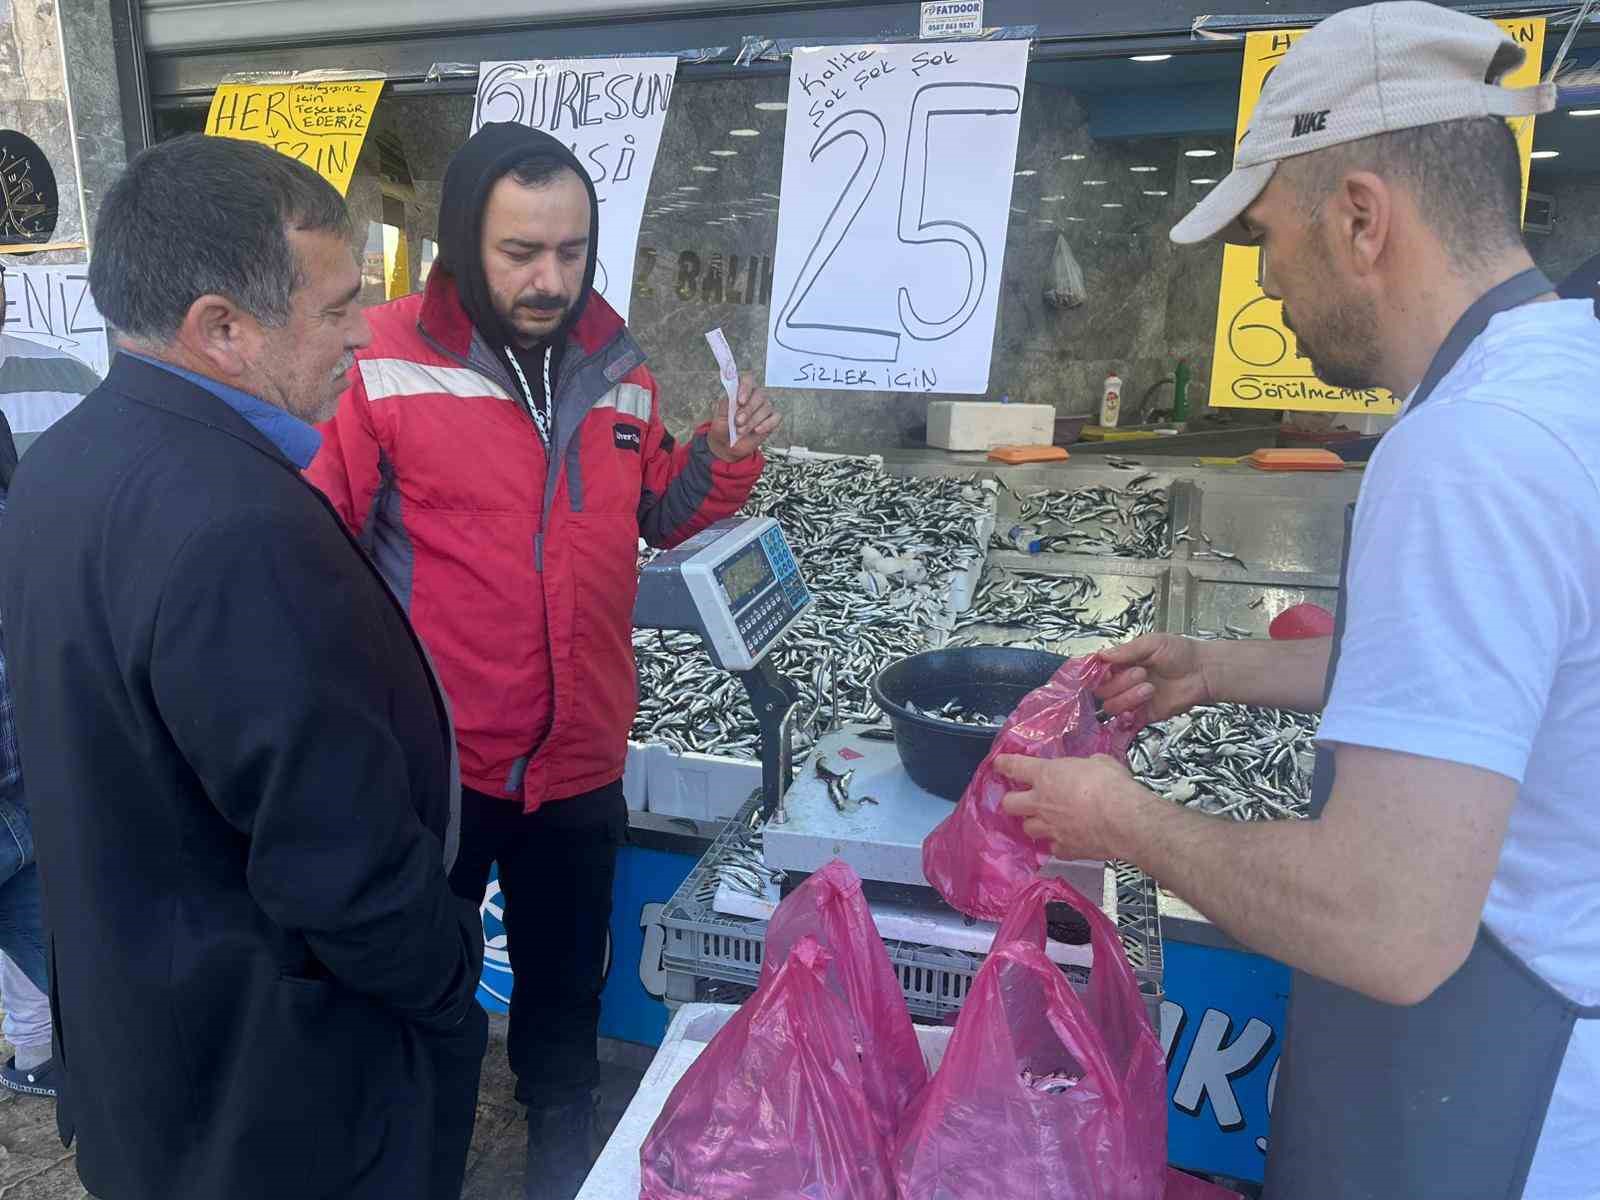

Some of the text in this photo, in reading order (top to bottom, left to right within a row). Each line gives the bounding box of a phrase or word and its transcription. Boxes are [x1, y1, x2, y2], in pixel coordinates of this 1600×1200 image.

[936, 3, 979, 15] FATDOOR
[798, 49, 876, 96] Kalite
[215, 91, 292, 134] HER
[1291, 110, 1330, 138] NIKE
[774, 81, 1021, 363] 25
